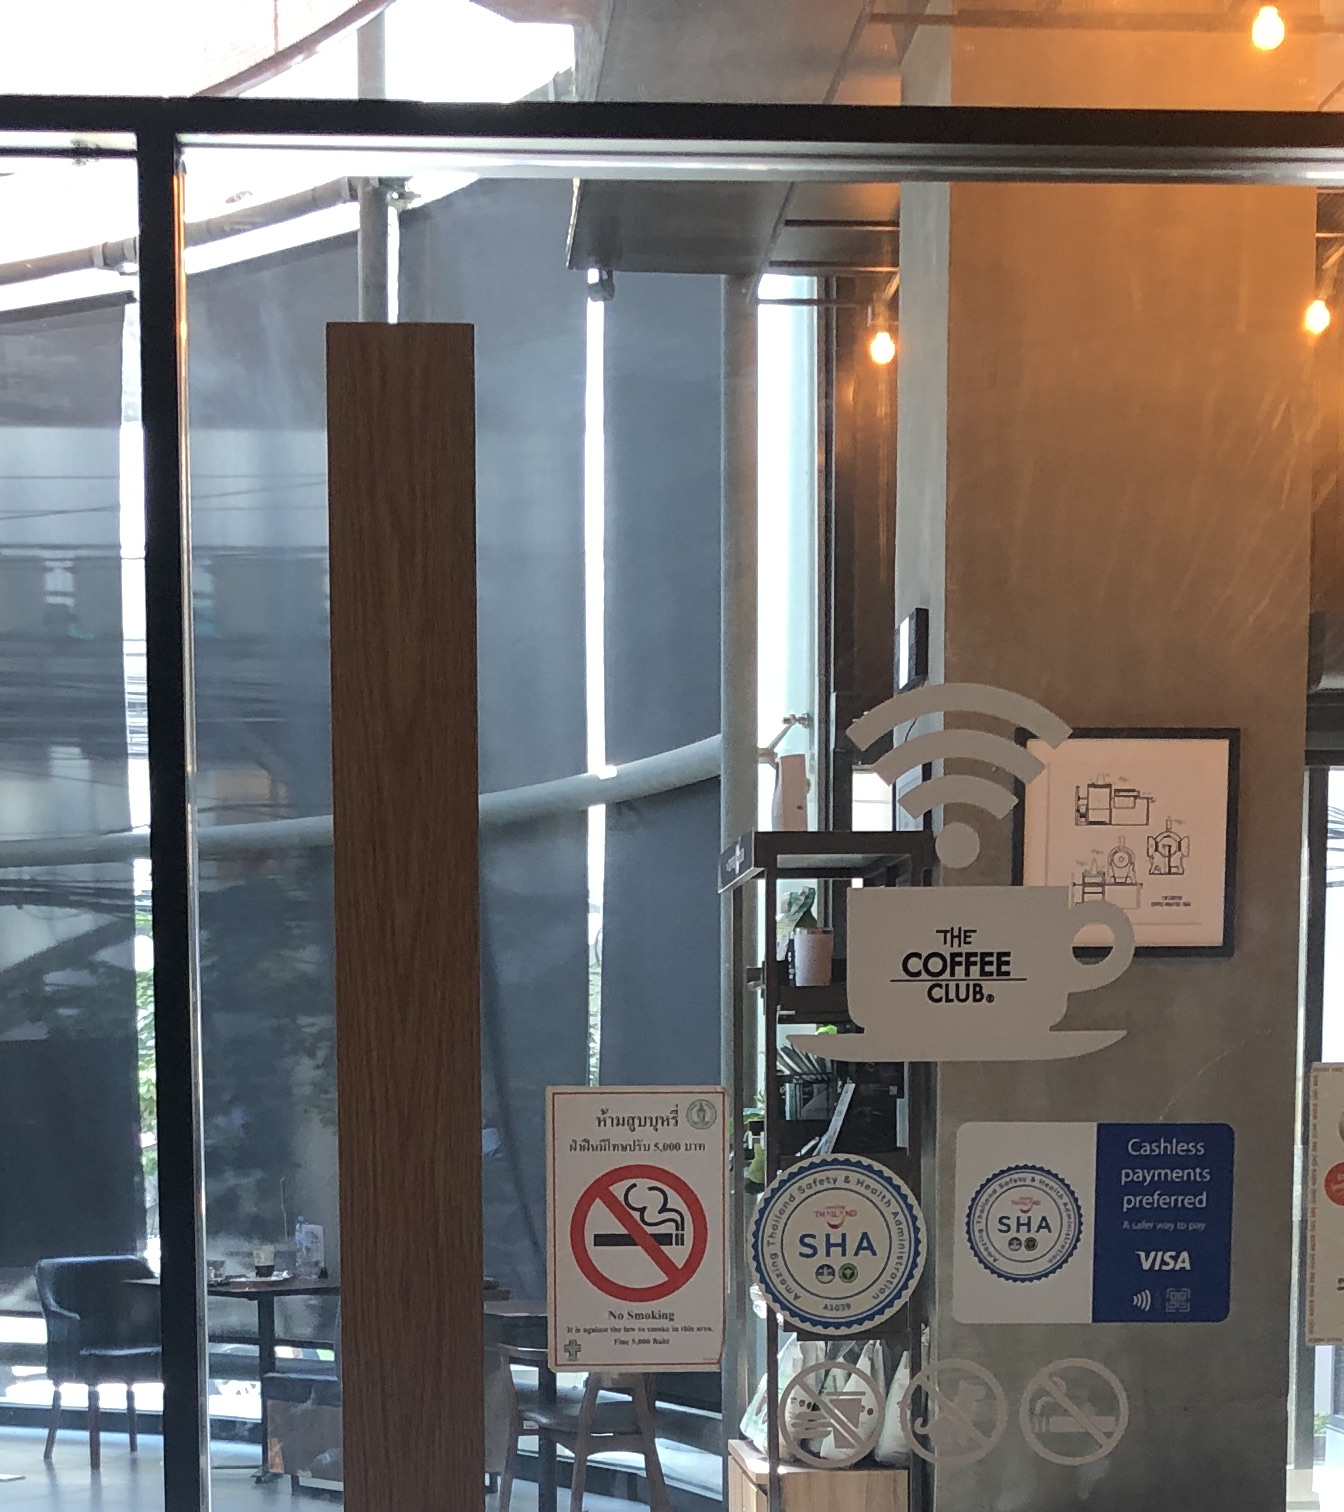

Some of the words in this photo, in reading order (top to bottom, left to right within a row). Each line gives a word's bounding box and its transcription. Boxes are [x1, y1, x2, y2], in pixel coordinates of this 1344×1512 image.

[935, 926, 977, 949] THE
[901, 951, 1011, 978] COFFEE
[596, 1103, 679, 1132] ห้ามสูบบุหรี่
[654, 1141, 681, 1152] 5,000
[1127, 1137, 1205, 1156] Cashless
[798, 1175, 838, 1195] Safety
[843, 1175, 851, 1184] &
[1120, 1167, 1211, 1186] payments
[855, 1177, 893, 1208] Health
[1122, 1190, 1207, 1212] preferred
[767, 1194, 796, 1248] Thailand
[997, 1215, 1052, 1234] SHA
[1131, 1220, 1154, 1230] safer
[1156, 1222, 1174, 1232] way
[1188, 1221, 1206, 1232] pay
[798, 1231, 878, 1259] SHA
[871, 1210, 907, 1300] Administration
[1134, 1250, 1191, 1270] VISA
[769, 1252, 802, 1301] Amazing
[608, 1310, 624, 1321] No
[626, 1310, 675, 1322] Smoking
